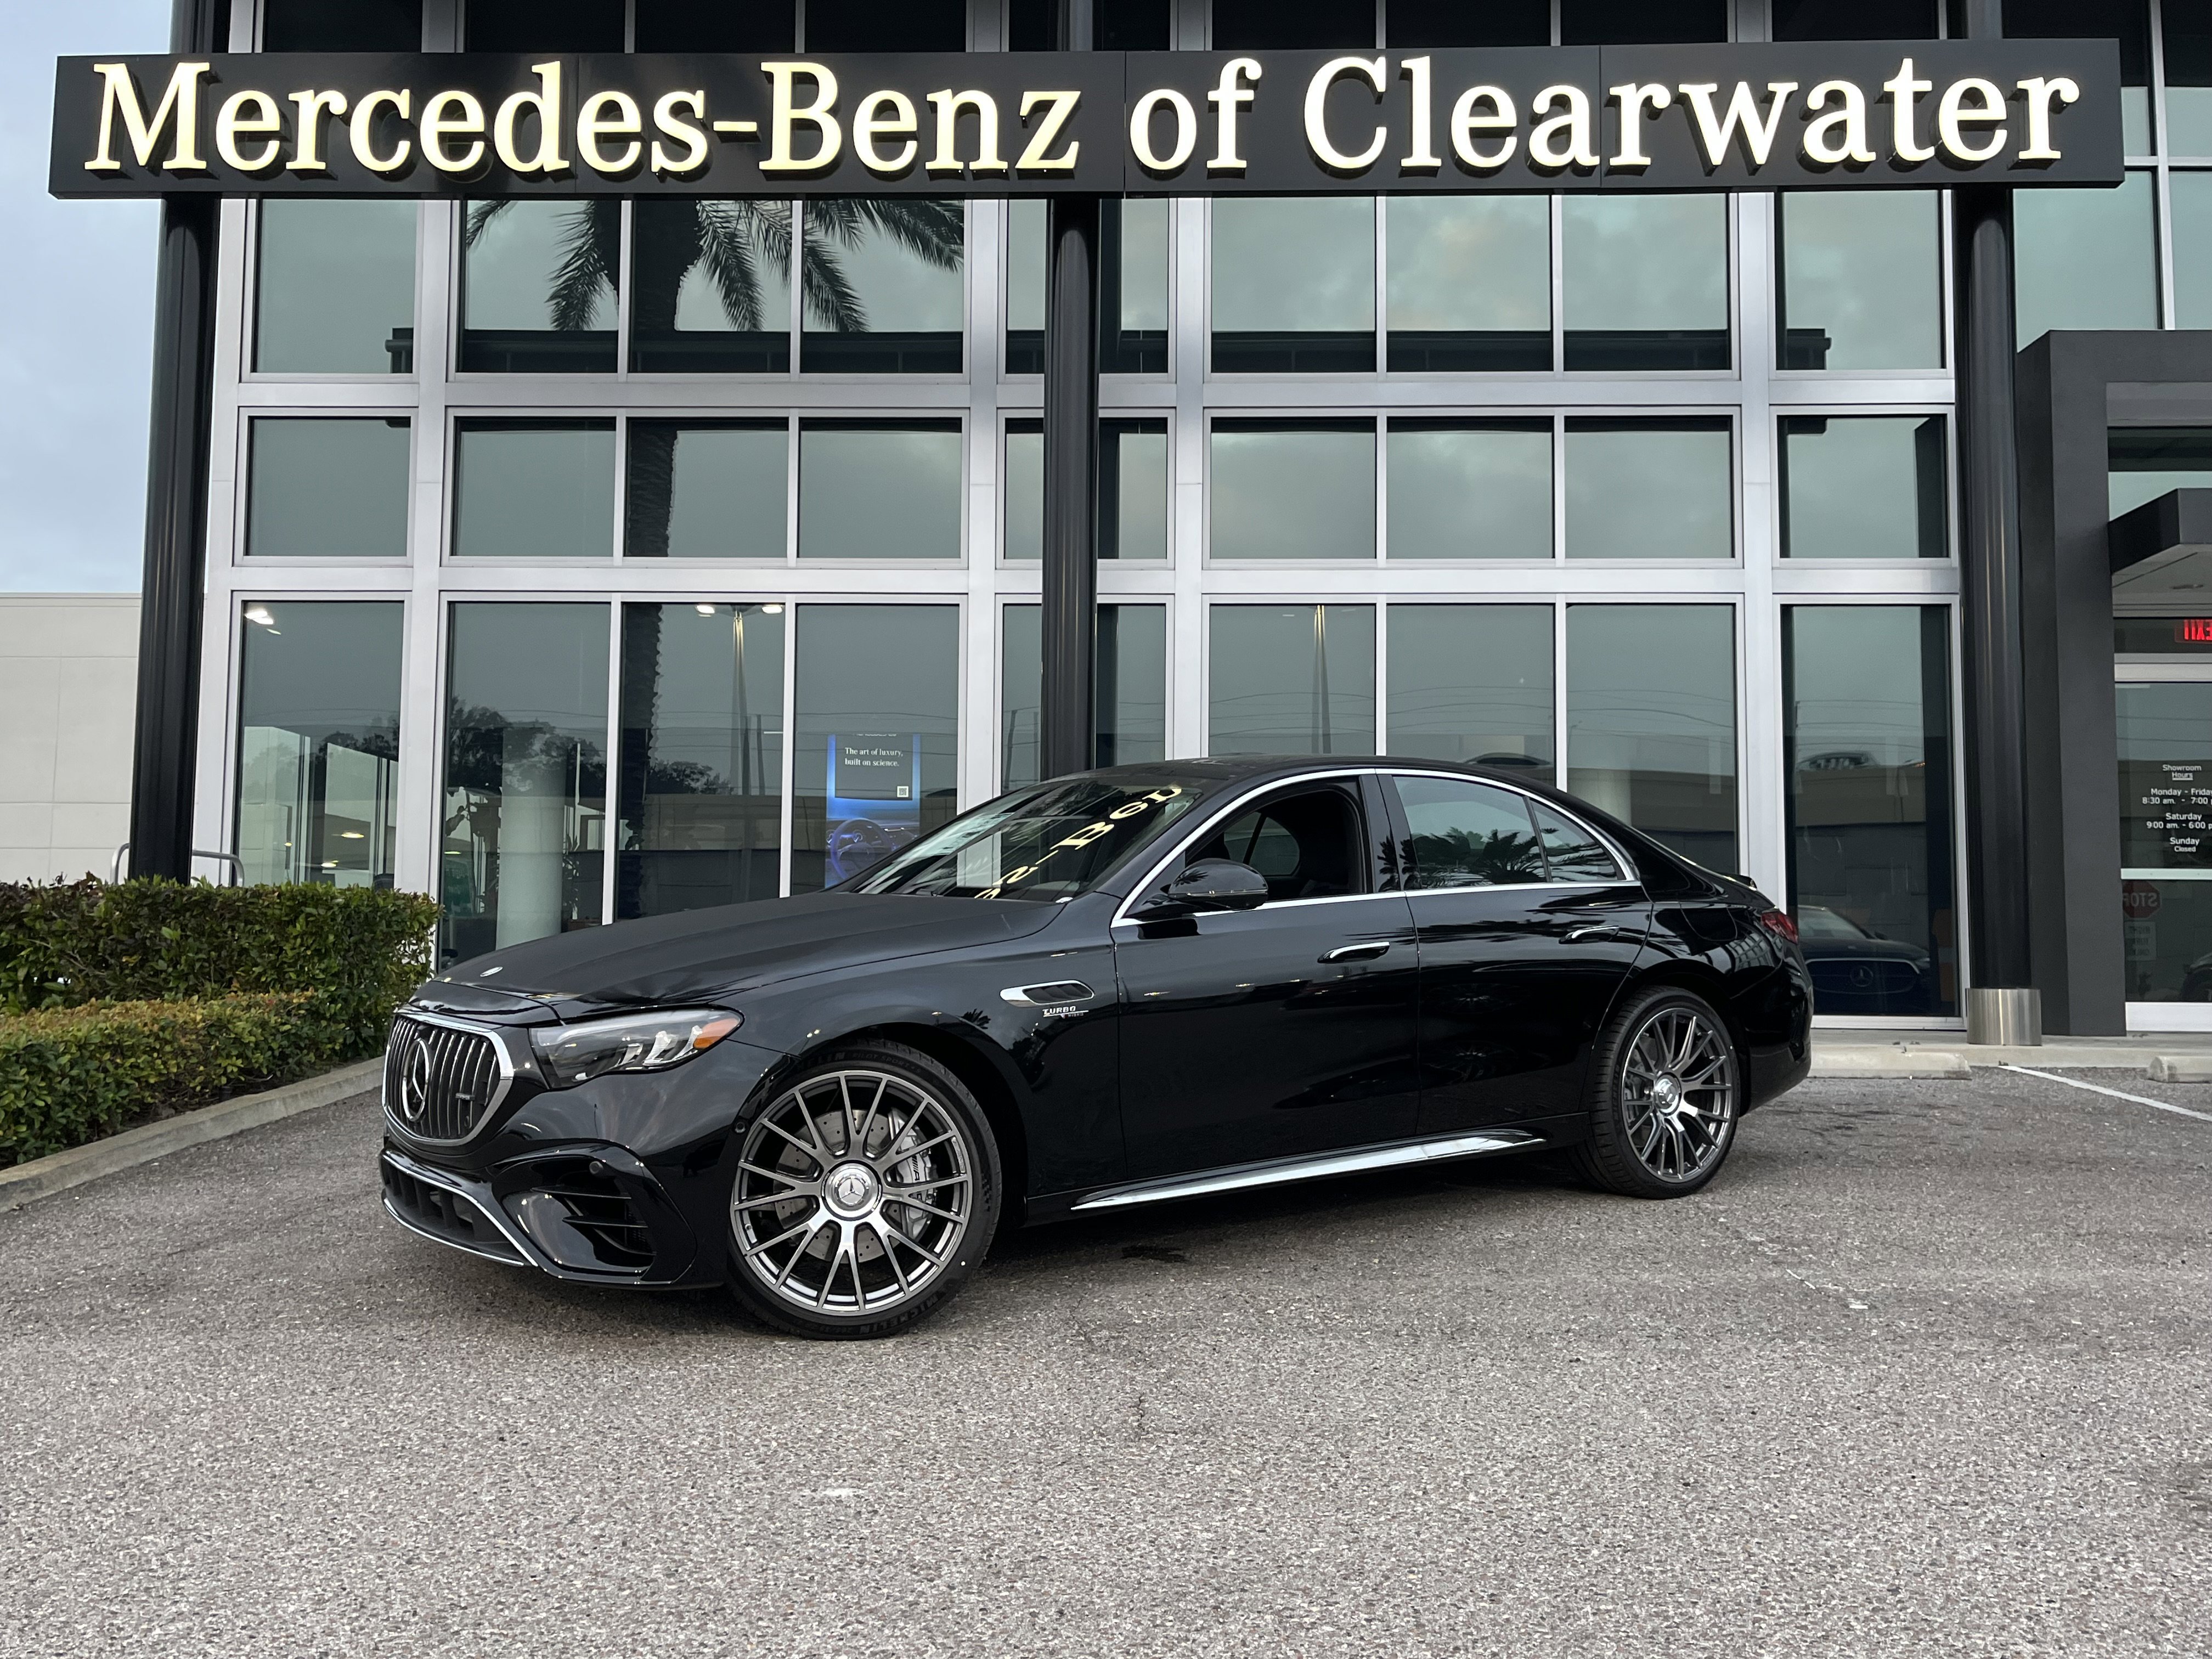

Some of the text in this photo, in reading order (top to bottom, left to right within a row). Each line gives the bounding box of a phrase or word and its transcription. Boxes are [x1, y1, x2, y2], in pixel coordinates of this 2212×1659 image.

[84, 56, 2080, 173] Mercedes-Benz of Clearwater
[879, 748, 903, 757] luxury,
[845, 758, 861, 766] built
[2151, 788, 2182, 797] Monday
[2191, 797, 2208, 805] 7:00
[2165, 812, 2202, 821] Saturday
[2170, 837, 2200, 846] Sunday
[1042, 1006, 1076, 1015] TURBO
